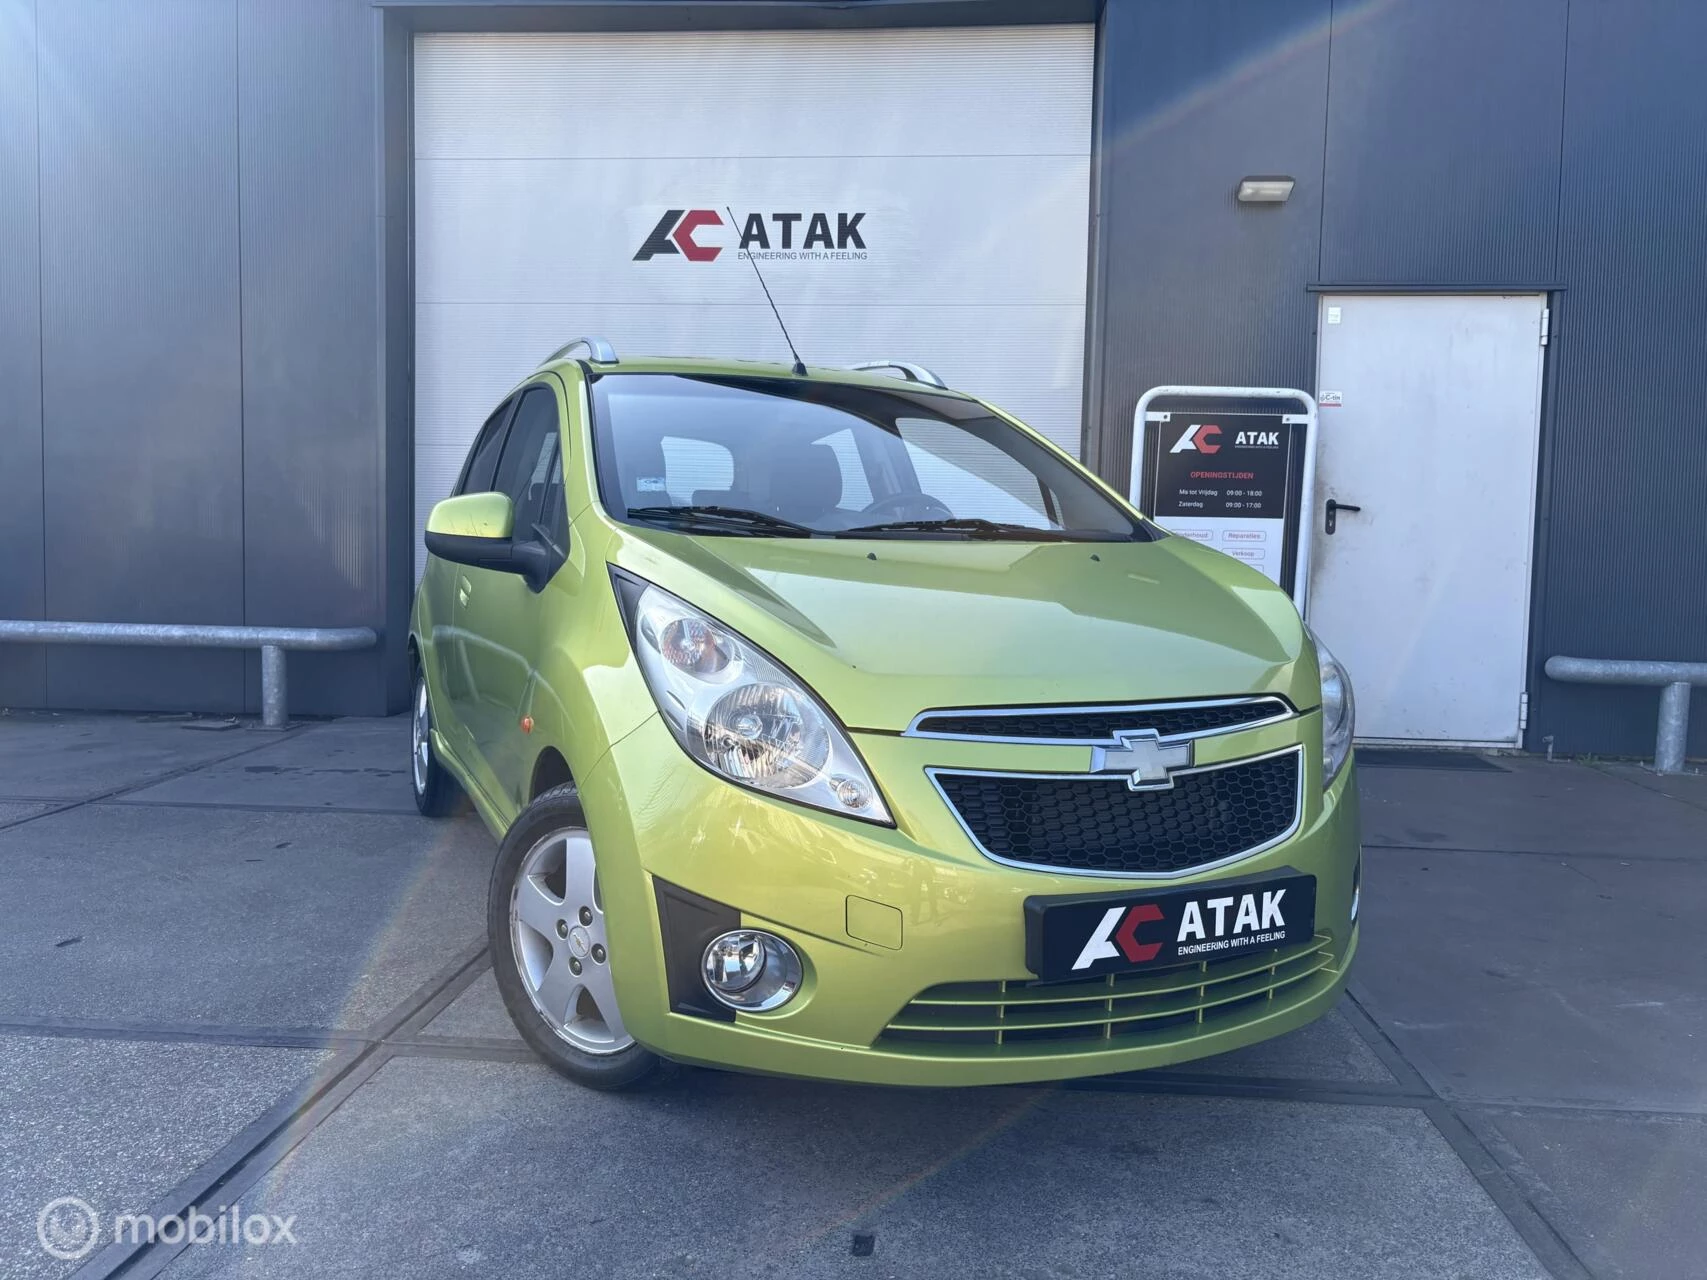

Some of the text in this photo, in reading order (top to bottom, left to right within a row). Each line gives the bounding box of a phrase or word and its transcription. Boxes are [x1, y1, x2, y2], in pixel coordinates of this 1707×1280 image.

[738, 212, 867, 250] ATAK
[737, 251, 868, 261] ENGINEERING WITH A FEELING
[1235, 431, 1279, 445] ATAK
[1190, 471, 1254, 480] OPENINGSTIJDEN
[1198, 489, 1218, 498] Vrijdag
[1226, 489, 1243, 497] 09:00
[1178, 500, 1204, 509] Zaterdag
[1228, 531, 1261, 540] Reparaties
[1177, 889, 1287, 942] ATAK
[1177, 930, 1286, 956] ENGINEERING WITH A FEELING
